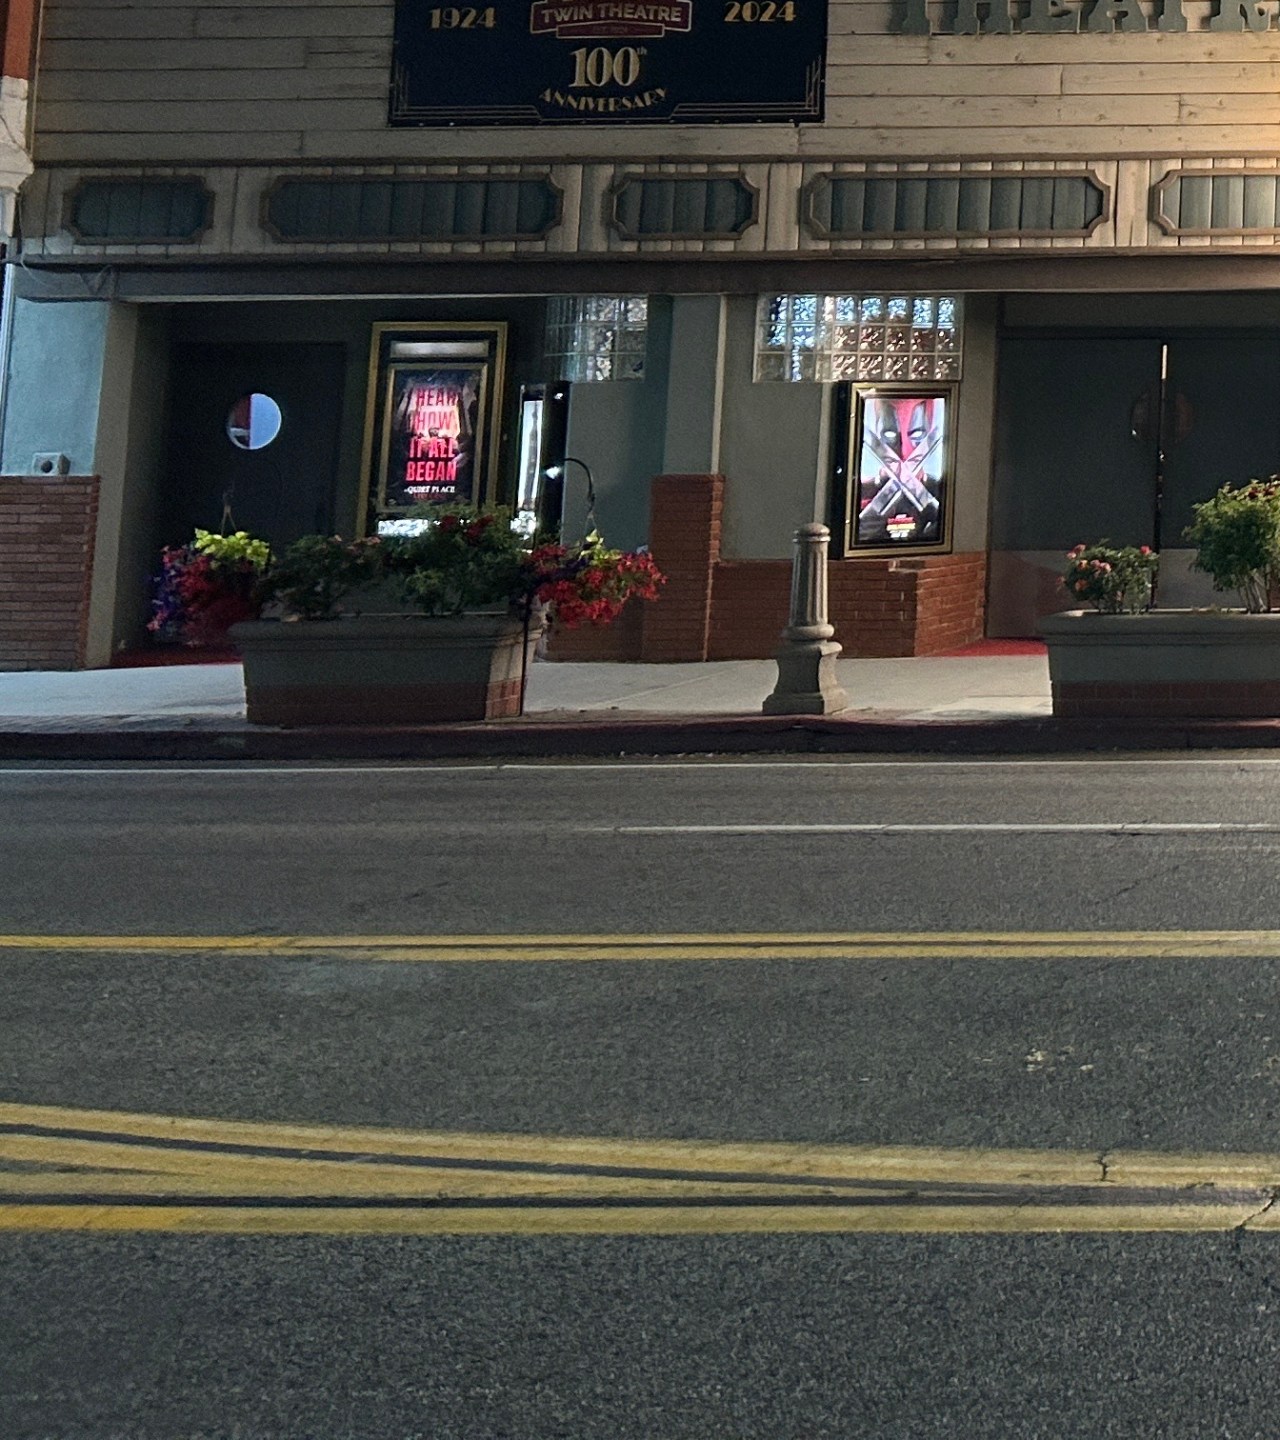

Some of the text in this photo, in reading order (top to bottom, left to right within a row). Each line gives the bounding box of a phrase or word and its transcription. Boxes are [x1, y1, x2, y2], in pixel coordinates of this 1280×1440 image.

[428, 6, 497, 30] 1924
[541, 2, 683, 23] TWIN THEATRE
[722, 0, 798, 24] 2024
[538, 87, 669, 112] ANNIVERSARY
[415, 386, 460, 407] HEAR
[409, 436, 456, 458] IT ALL
[405, 461, 458, 482] BEGAN
